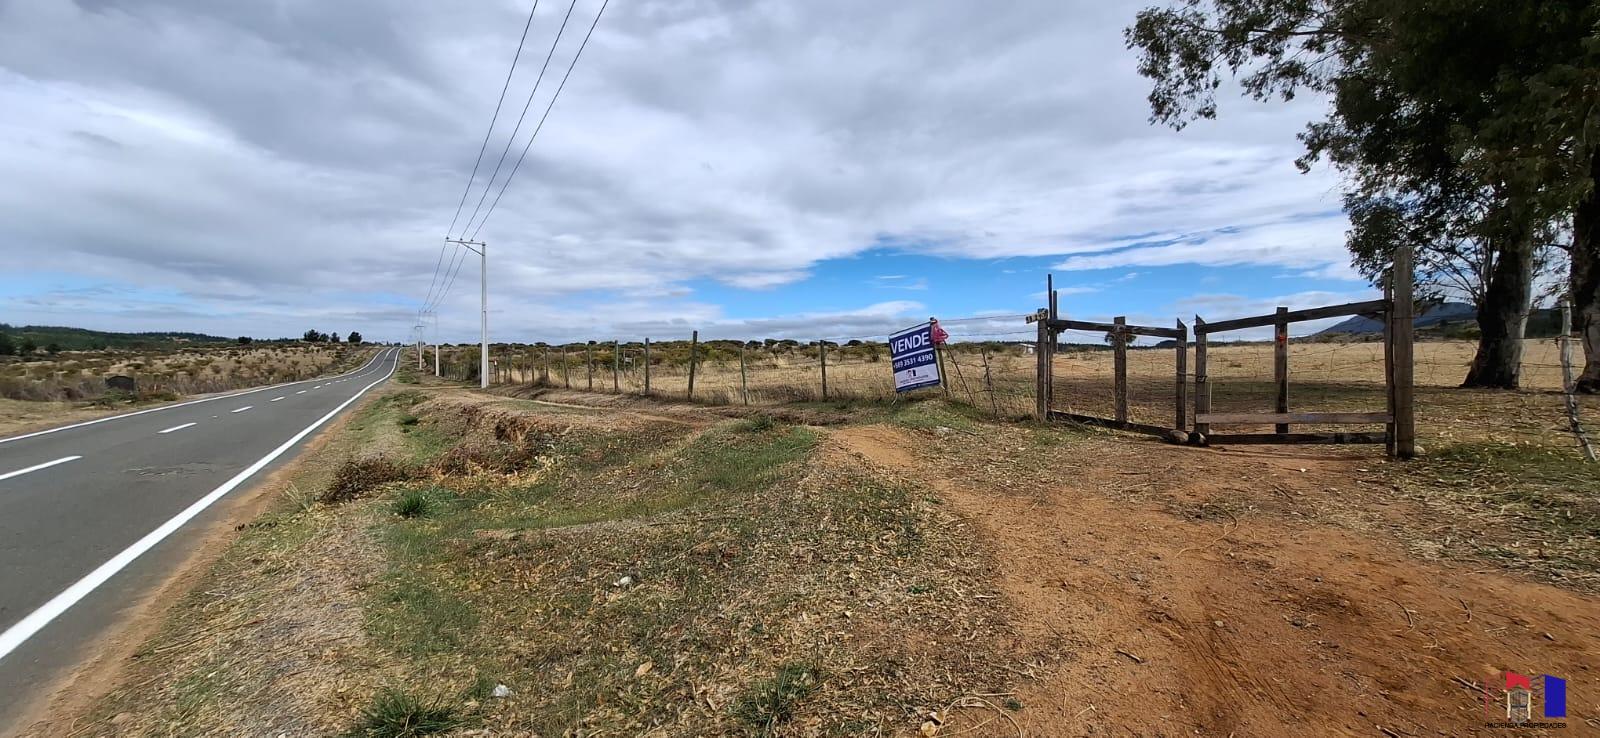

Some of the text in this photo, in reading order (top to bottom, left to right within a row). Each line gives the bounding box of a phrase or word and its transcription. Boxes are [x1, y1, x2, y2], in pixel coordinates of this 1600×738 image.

[890, 331, 930, 354] VENDE
[904, 357, 916, 367] 3531
[917, 353, 934, 363] 4390
